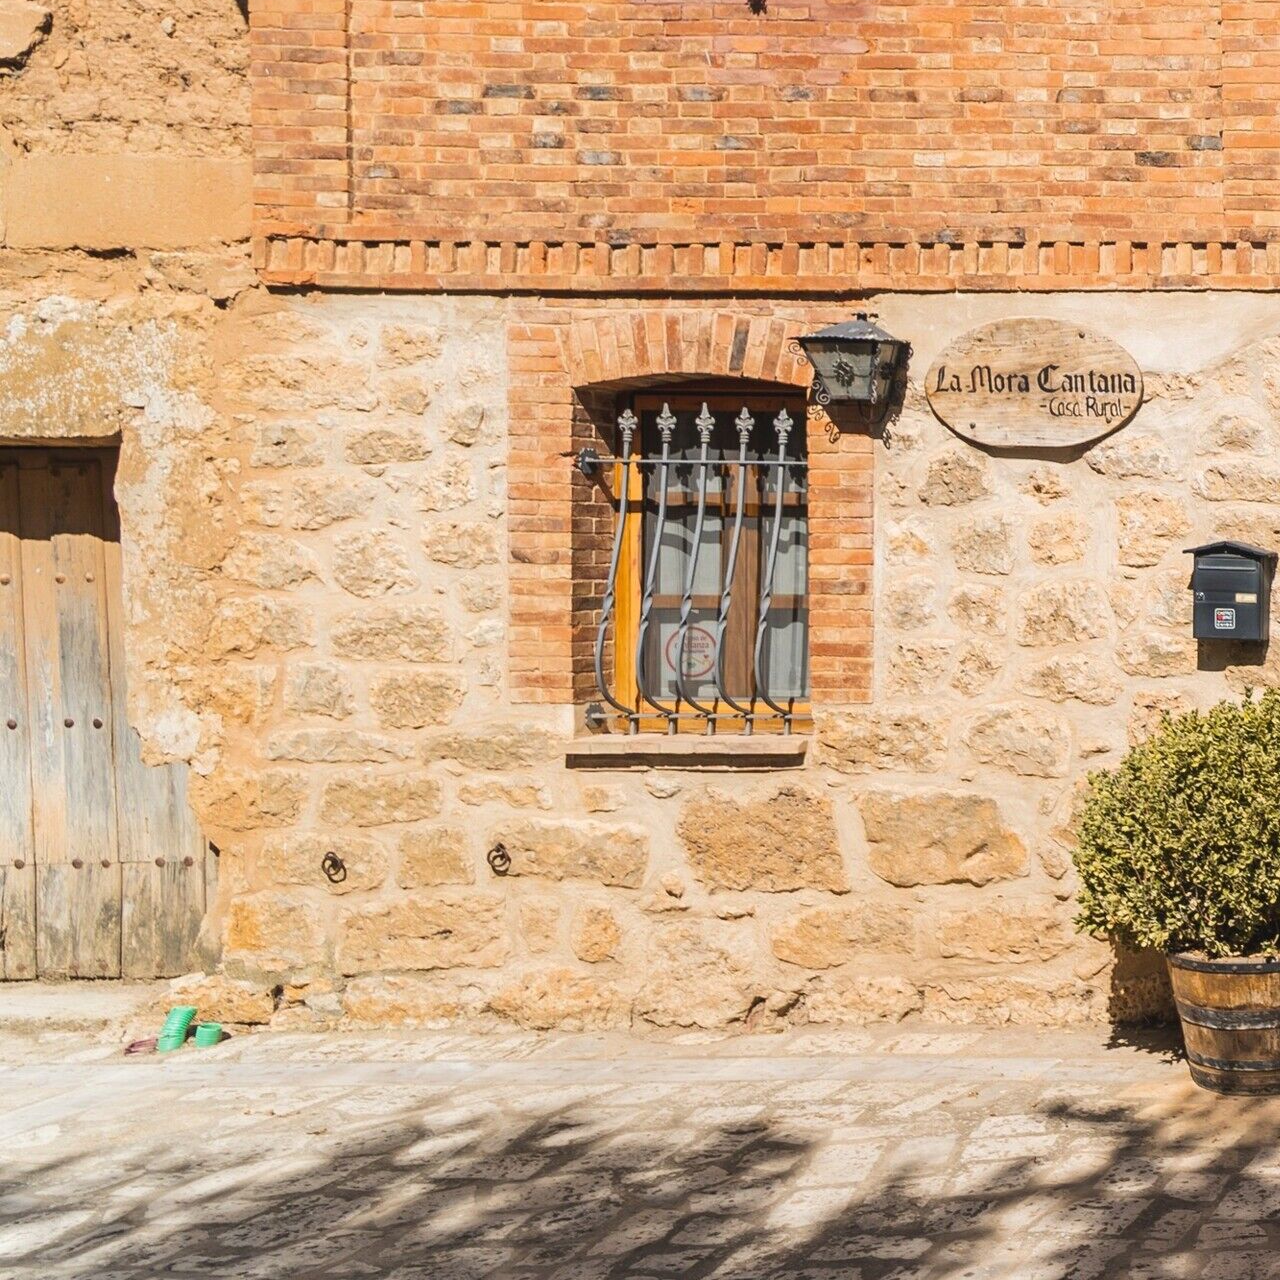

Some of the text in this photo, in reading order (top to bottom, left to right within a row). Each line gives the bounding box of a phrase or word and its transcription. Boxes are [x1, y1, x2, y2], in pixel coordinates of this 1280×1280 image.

[936, 364, 1136, 393] La Mora Cantana
